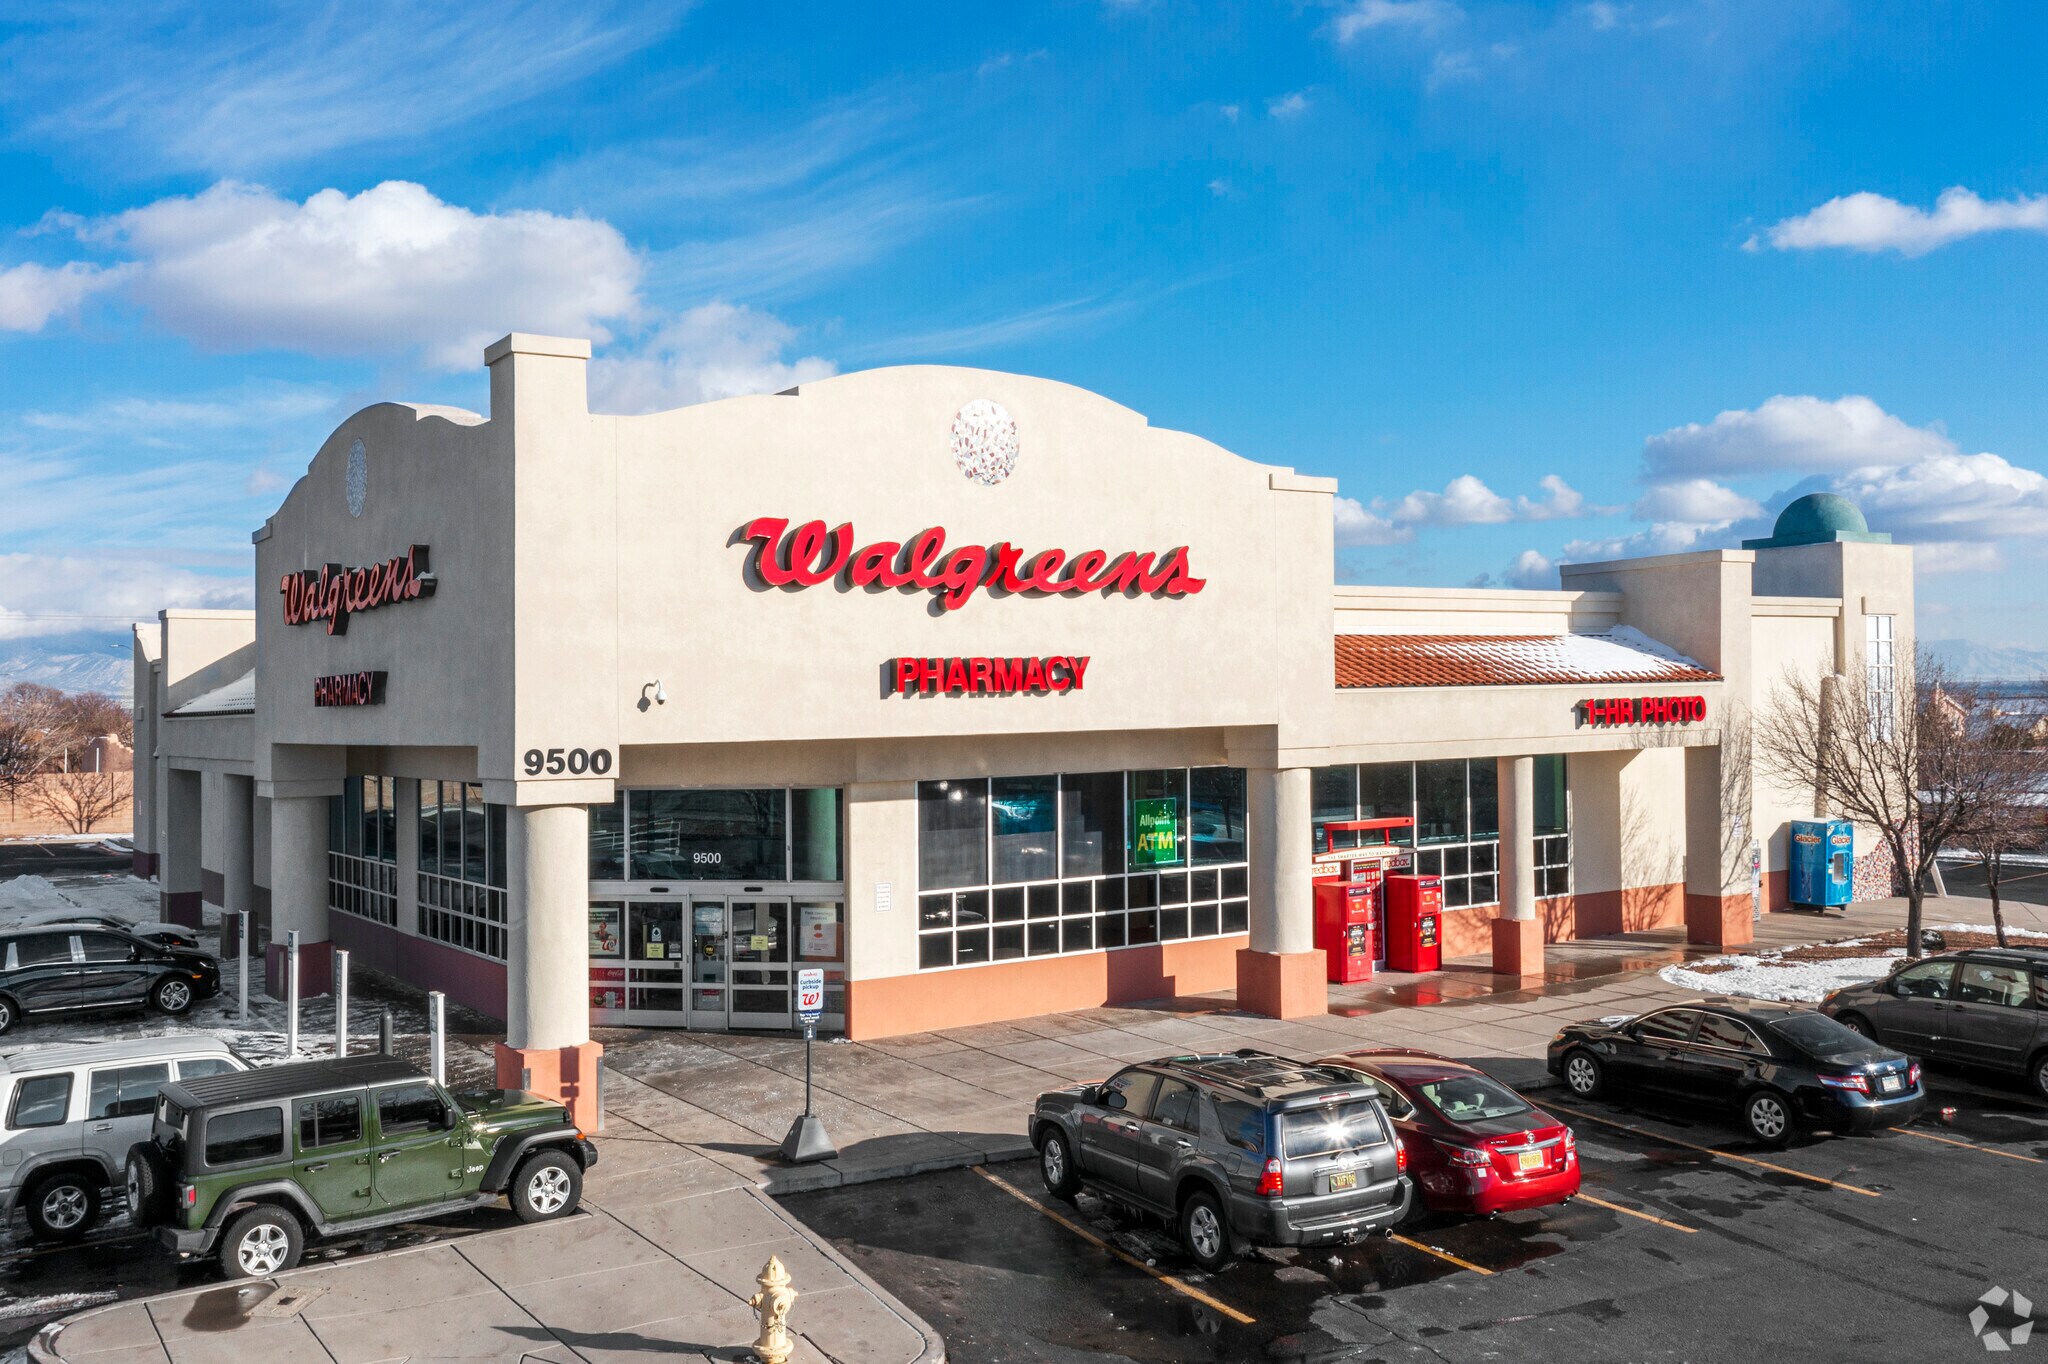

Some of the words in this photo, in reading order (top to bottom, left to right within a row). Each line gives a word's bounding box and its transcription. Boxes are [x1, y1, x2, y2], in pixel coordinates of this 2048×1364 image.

[744, 516, 1207, 610] Walgreens
[280, 544, 424, 636] Walgreens
[314, 671, 376, 707] PHARMACY
[897, 655, 1091, 694] PHARMACY
[1585, 697, 1634, 725] 1-HR
[1641, 695, 1707, 723] PHOTO
[524, 748, 612, 776] 9500
[1139, 813, 1170, 828] Allpoint
[1137, 831, 1173, 851] ATM
[693, 852, 722, 864] 9500
[466, 1164, 484, 1173] Jeep
